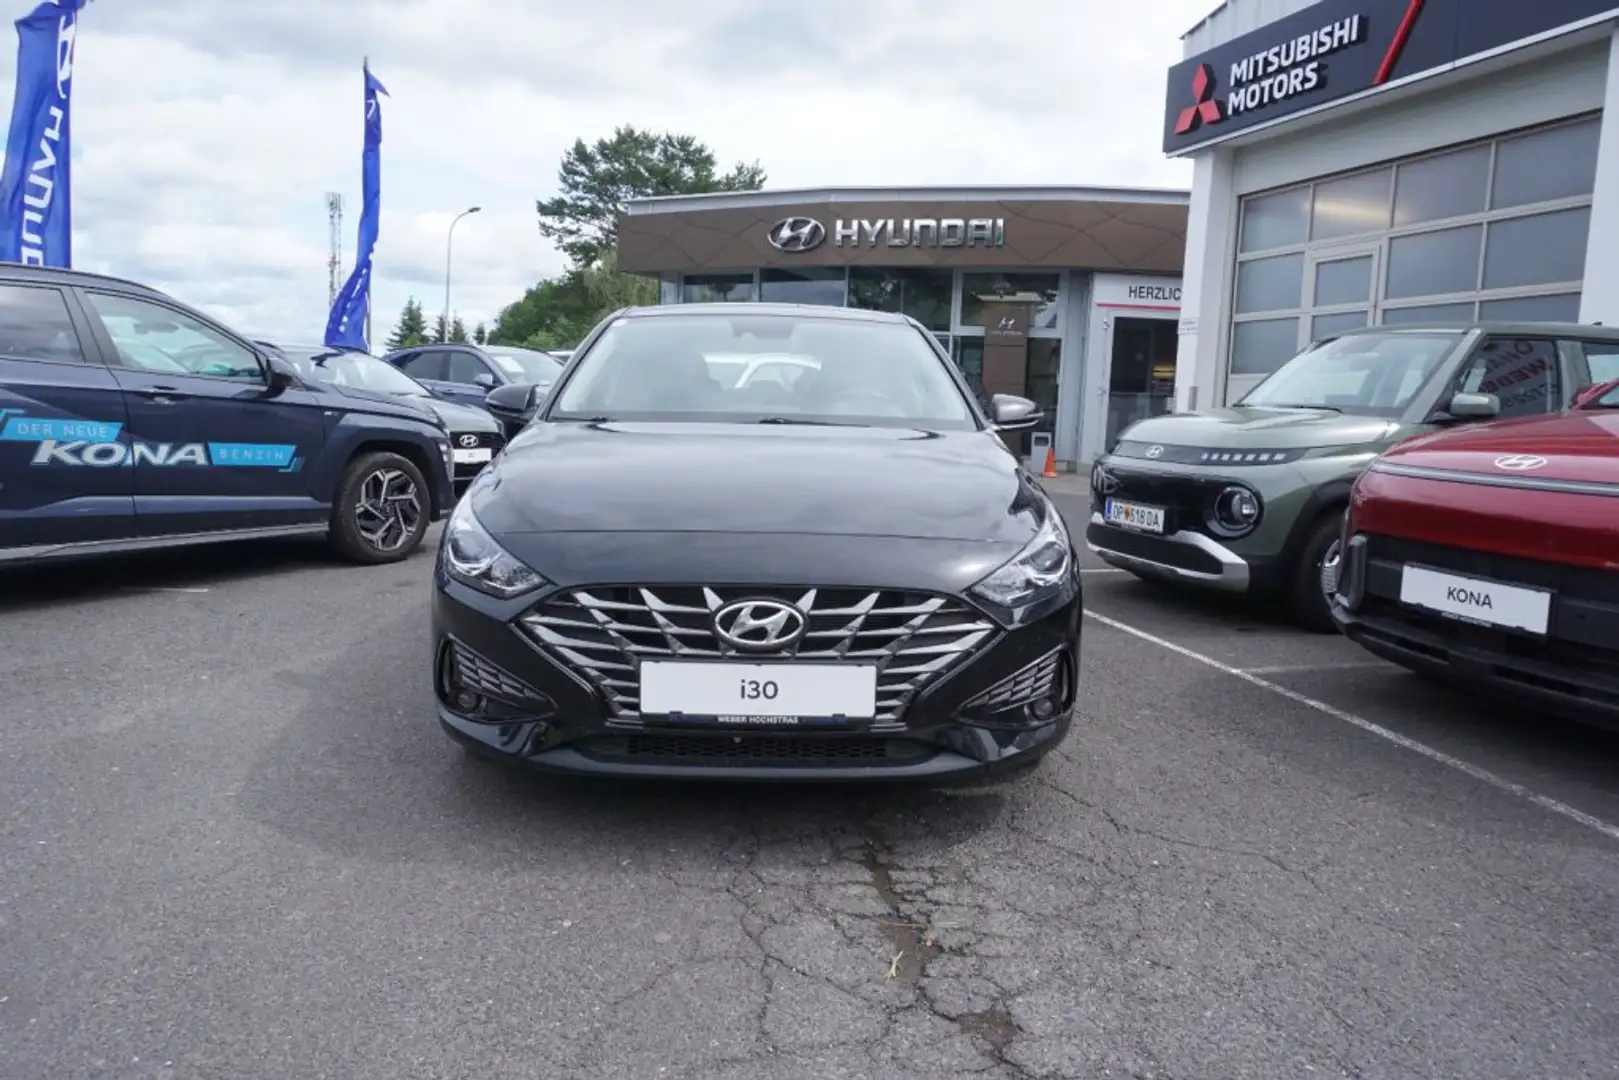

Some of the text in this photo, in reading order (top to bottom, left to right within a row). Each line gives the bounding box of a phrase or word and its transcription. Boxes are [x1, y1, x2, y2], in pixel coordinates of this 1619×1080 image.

[1229, 13, 1359, 87] MITSUBISHI
[1227, 61, 1318, 116] MOTORS
[835, 218, 1004, 247] HYUNDAI
[1128, 285, 1182, 301] HERZLIC
[18, 423, 109, 438] DER NEUE
[30, 439, 284, 467] KONA BENZIN
[1447, 586, 1493, 609] KONA
[740, 679, 779, 700] i30
